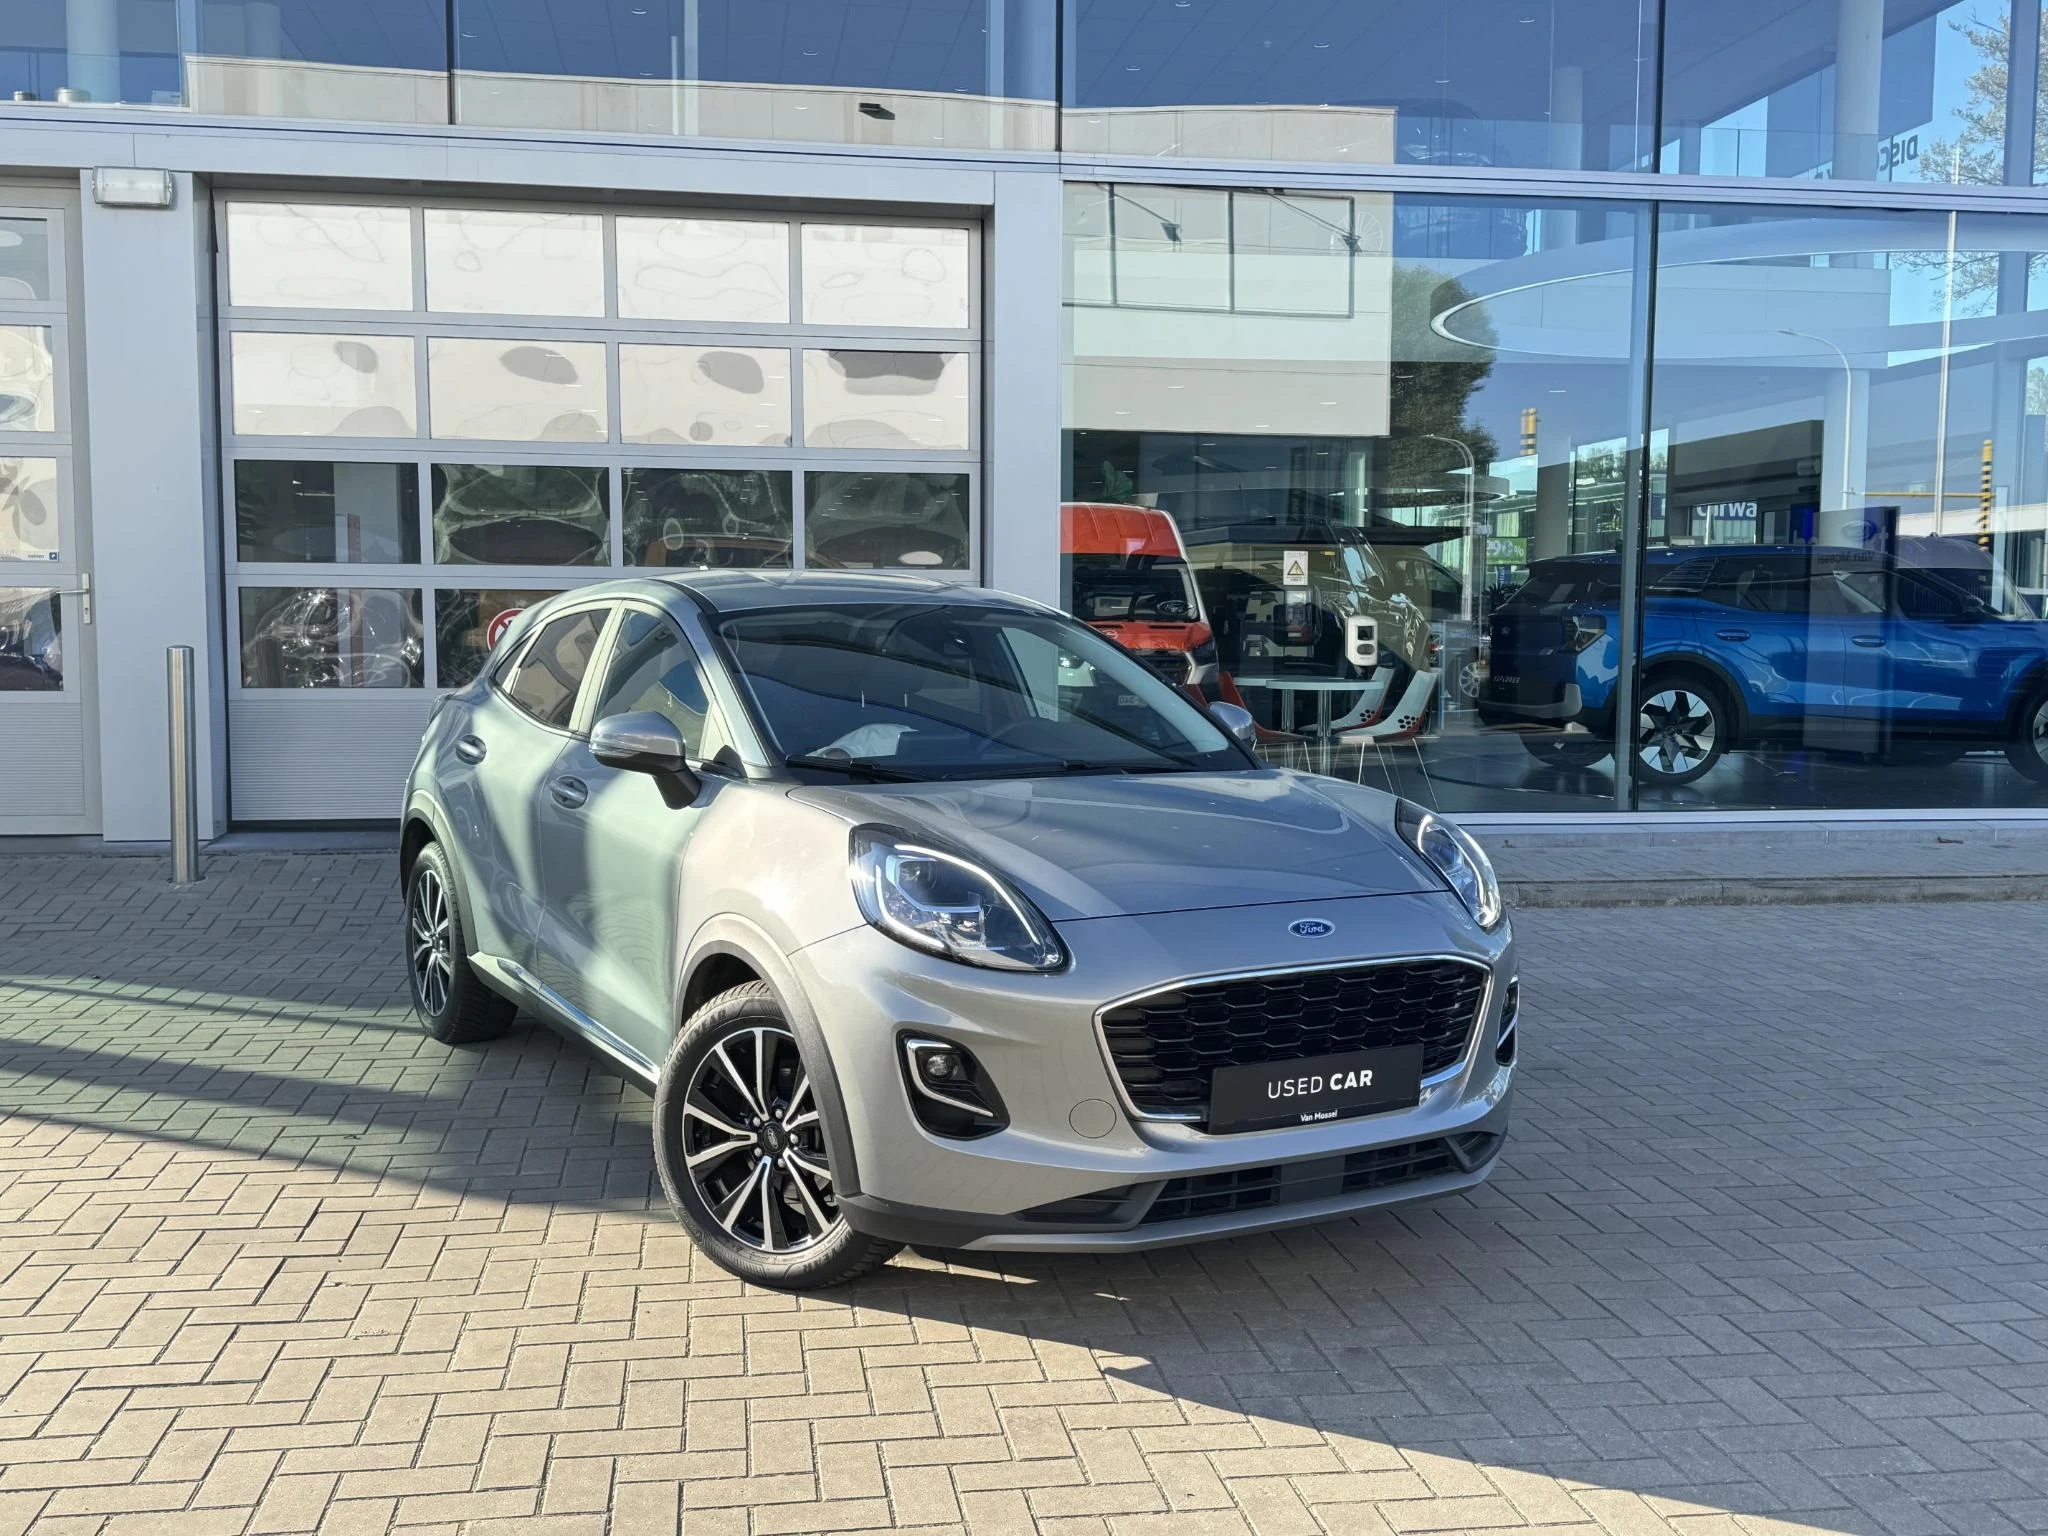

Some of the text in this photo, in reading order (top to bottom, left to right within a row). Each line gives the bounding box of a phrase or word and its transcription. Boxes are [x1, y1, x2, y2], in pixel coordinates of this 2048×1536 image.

[1300, 922, 1325, 934] Ford
[1268, 1069, 1373, 1099] USED CAR
[1300, 1109, 1338, 1122] Van Mossel
